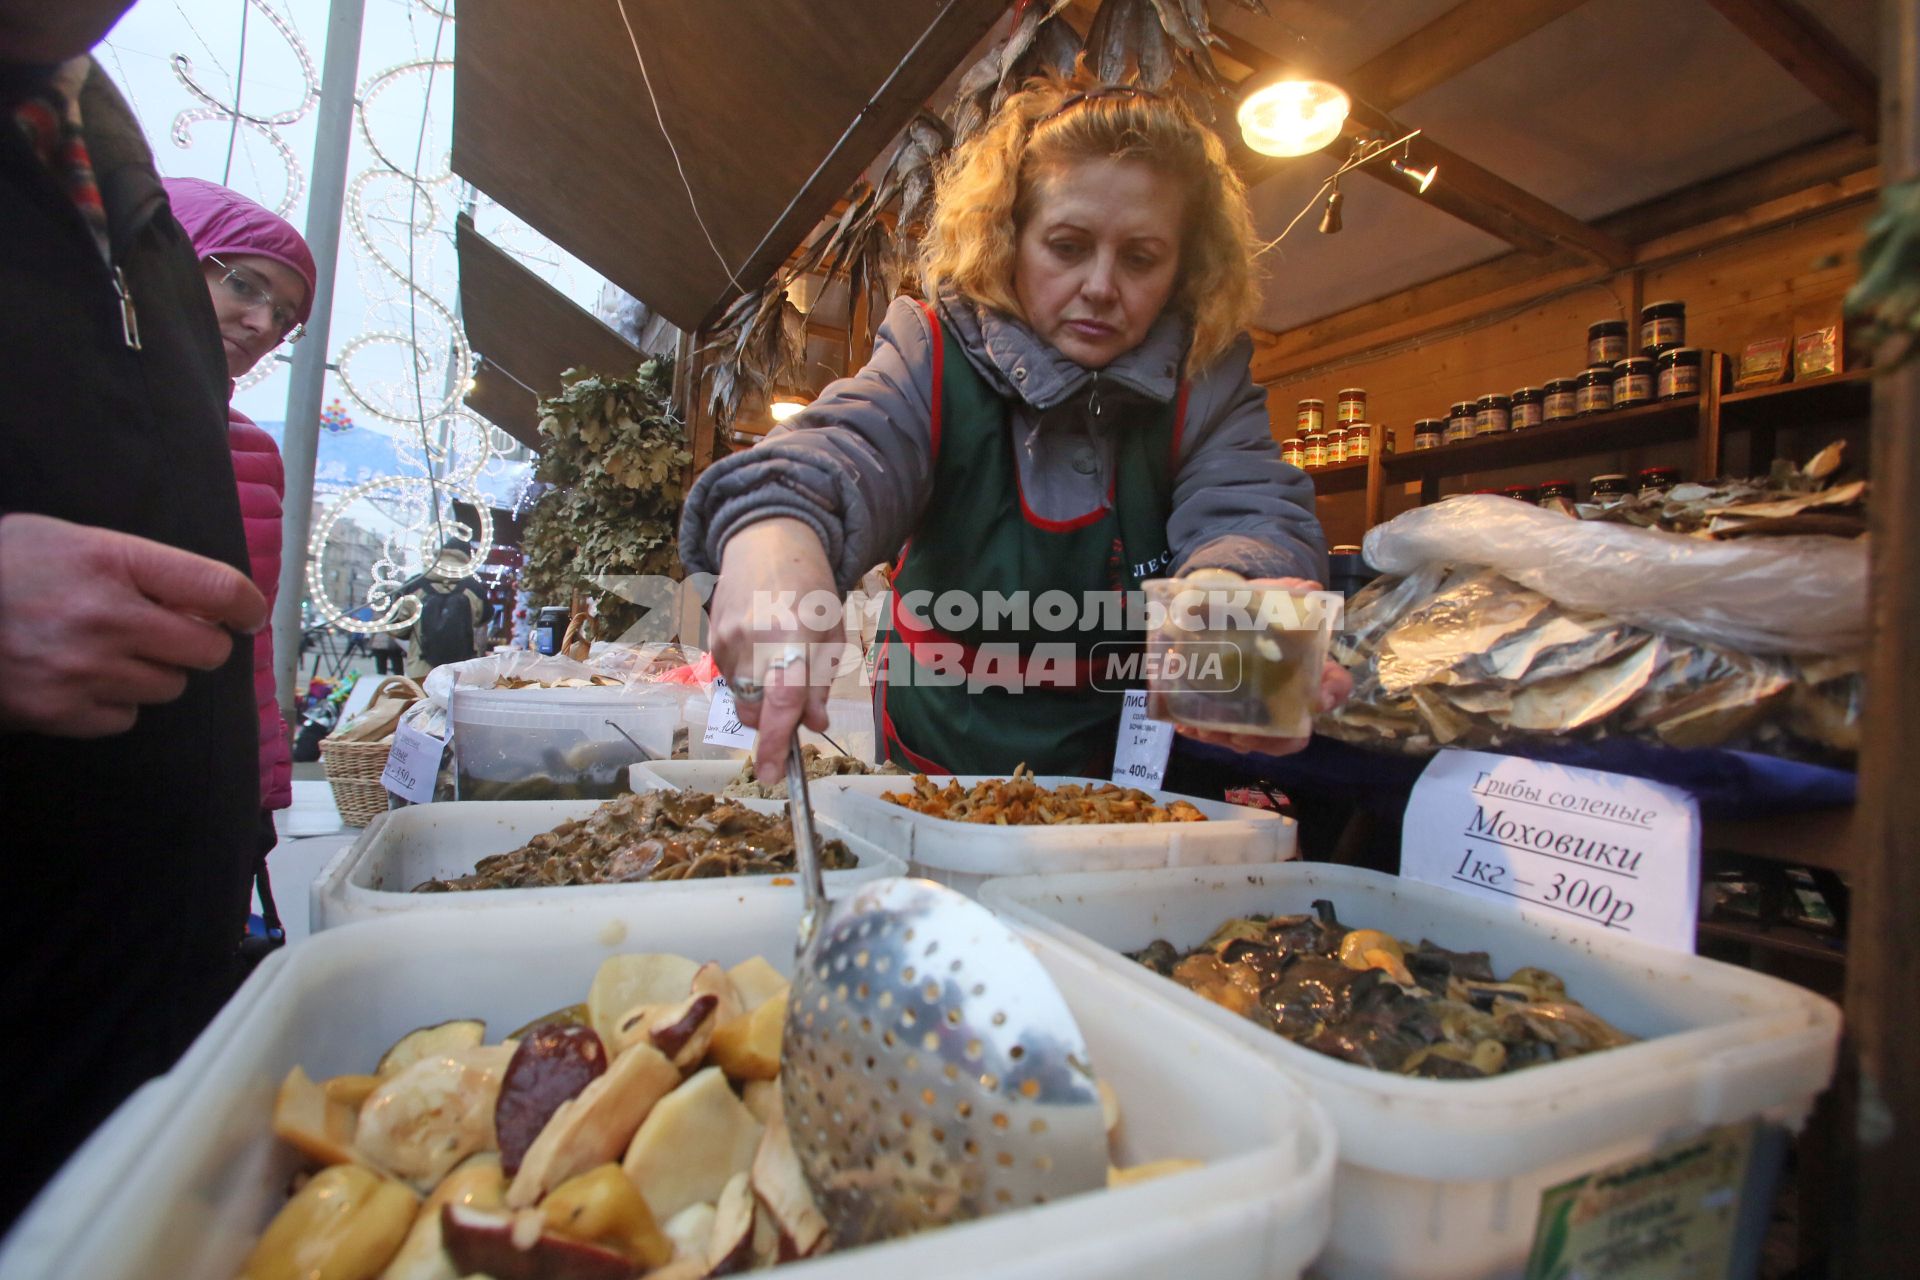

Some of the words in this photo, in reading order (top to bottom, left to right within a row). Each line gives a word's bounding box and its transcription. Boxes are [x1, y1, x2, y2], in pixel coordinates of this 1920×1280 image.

[1129, 763, 1147, 778] 400
[1473, 771, 1542, 802] Грибы
[1548, 791, 1657, 825] соленые
[1467, 805, 1643, 872] Моховики
[1456, 849, 1506, 885] 1кг
[1543, 872, 1635, 928] 300р
